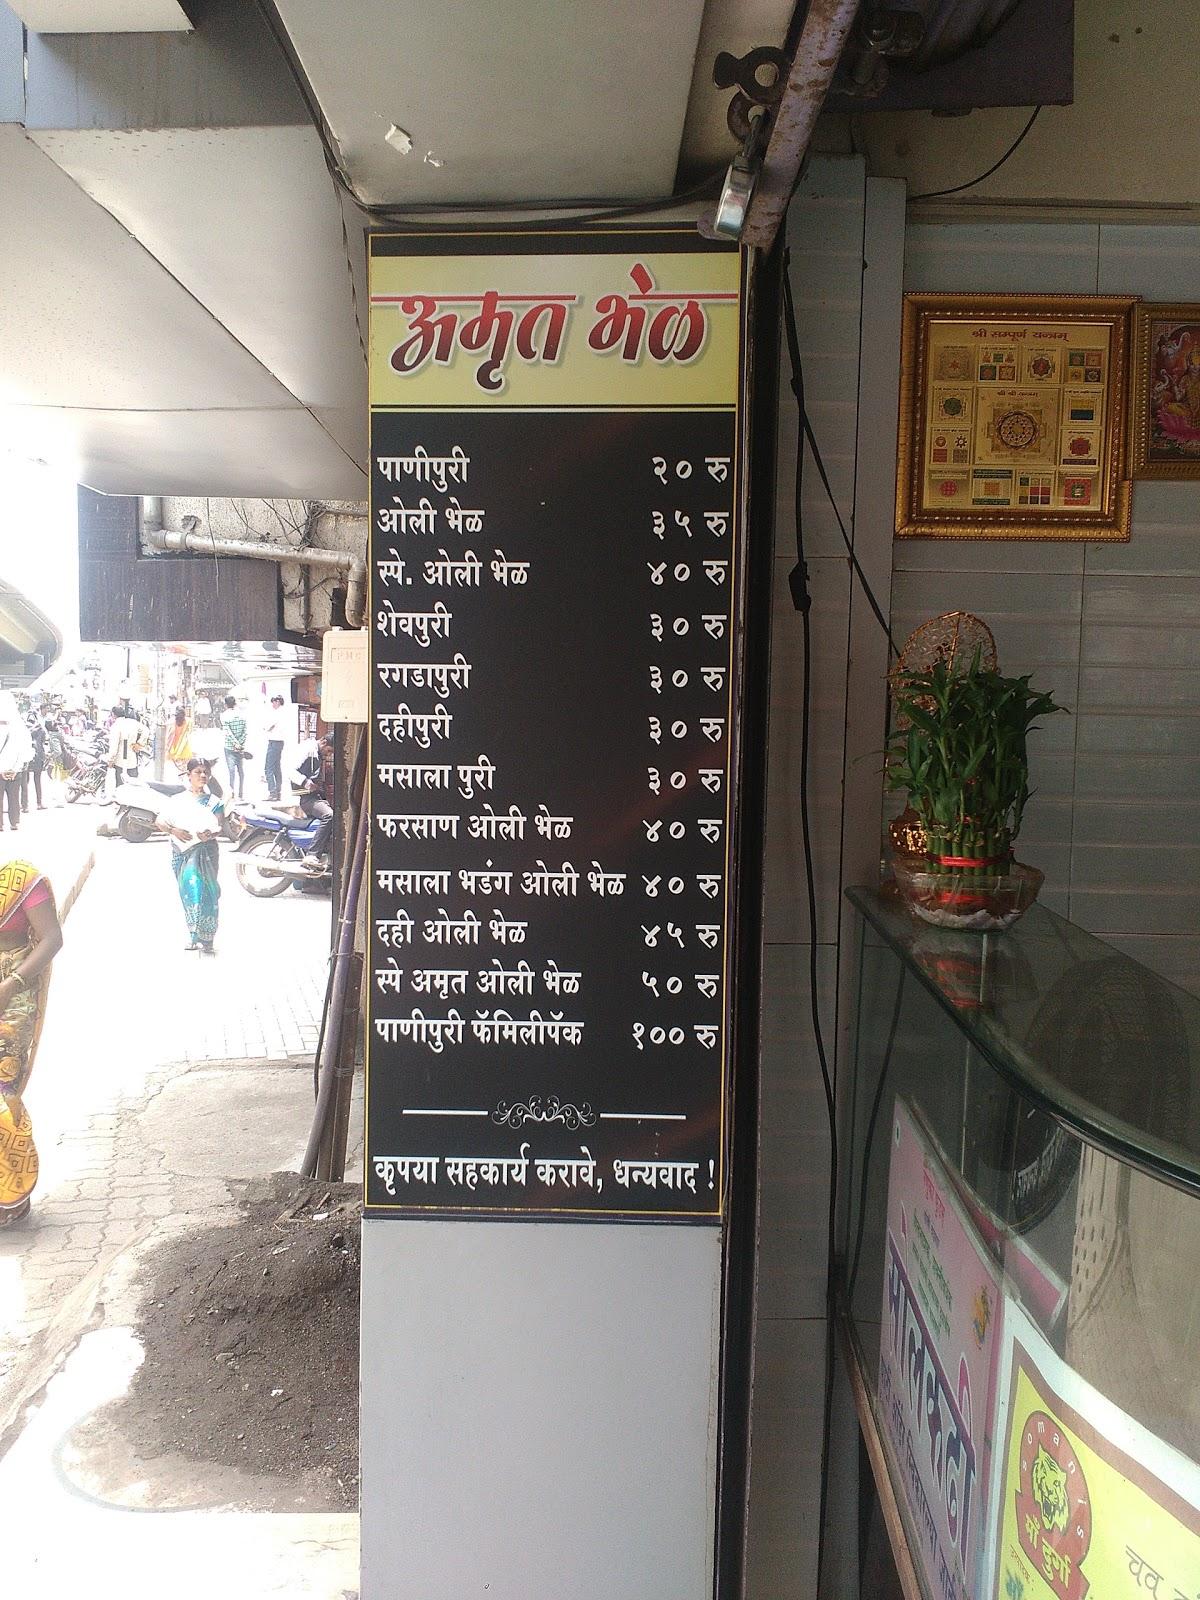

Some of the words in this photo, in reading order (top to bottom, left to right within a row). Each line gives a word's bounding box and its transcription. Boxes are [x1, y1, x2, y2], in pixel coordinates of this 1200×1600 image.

[371, 291, 577, 393] अमृत
[588, 262, 737, 364] भेळ
[377, 446, 470, 493] पाणीपुरी
[652, 456, 693, 485] २०
[704, 457, 731, 483] रु
[377, 496, 437, 535] ओली
[445, 497, 485, 535] भेळ
[651, 510, 693, 540] ३५
[704, 511, 730, 538] रु
[377, 548, 412, 587] स्पे.
[423, 549, 483, 587] ओली
[491, 549, 530, 587] भेळ
[647, 562, 691, 586] ४०
[703, 560, 729, 586] रु
[377, 599, 452, 648] शेवपुरी
[650, 613, 690, 642] ३०
[702, 614, 728, 640] रु
[377, 652, 472, 699] रगडापुरी
[649, 665, 689, 694] ३०
[701, 666, 726, 692] रु
[377, 702, 453, 748] दहीपुरी
[648, 716, 688, 744] ३०
[700, 717, 725, 743] रु
[377, 763, 452, 790] मसाला
[457, 754, 496, 799] पुरी
[648, 767, 687, 796] ३०
[698, 768, 724, 794] रु
[376, 814, 460, 840] फरसाण
[468, 804, 527, 841] ओली
[535, 804, 574, 840] भेळ
[643, 819, 686, 843] ४०
[698, 818, 723, 844] रु
[376, 869, 451, 895] मसाला
[459, 859, 513, 896] भडंग
[520, 860, 580, 897] ओली
[588, 860, 627, 897] भेळ
[642, 874, 685, 898] ४०
[697, 874, 722, 899] रु
[376, 908, 414, 948] दही
[422, 908, 481, 946] ओली
[489, 908, 528, 946] भेळ
[641, 921, 685, 948] ४५
[696, 924, 721, 950] रु
[375, 957, 403, 995] स्पे
[411, 969, 469, 1000] अमृत
[476, 959, 535, 996] ओली
[543, 959, 582, 996] भेळ
[641, 971, 683, 998] ५०
[695, 974, 720, 999] रु
[375, 1007, 465, 1053] पाणीपुरी
[471, 1008, 585, 1046] फॅमिलीपॅक
[631, 1022, 685, 1051] १००
[694, 1024, 719, 1050] रु
[373, 1155, 440, 1196] कृपया
[445, 1143, 530, 1191] सहकार्य
[535, 1146, 603, 1194] करावे,
[613, 1159, 699, 1194] धन्यवाद
[1042, 1537, 1072, 1591] दुर्गा
[1125, 1543, 1165, 1600] चव
